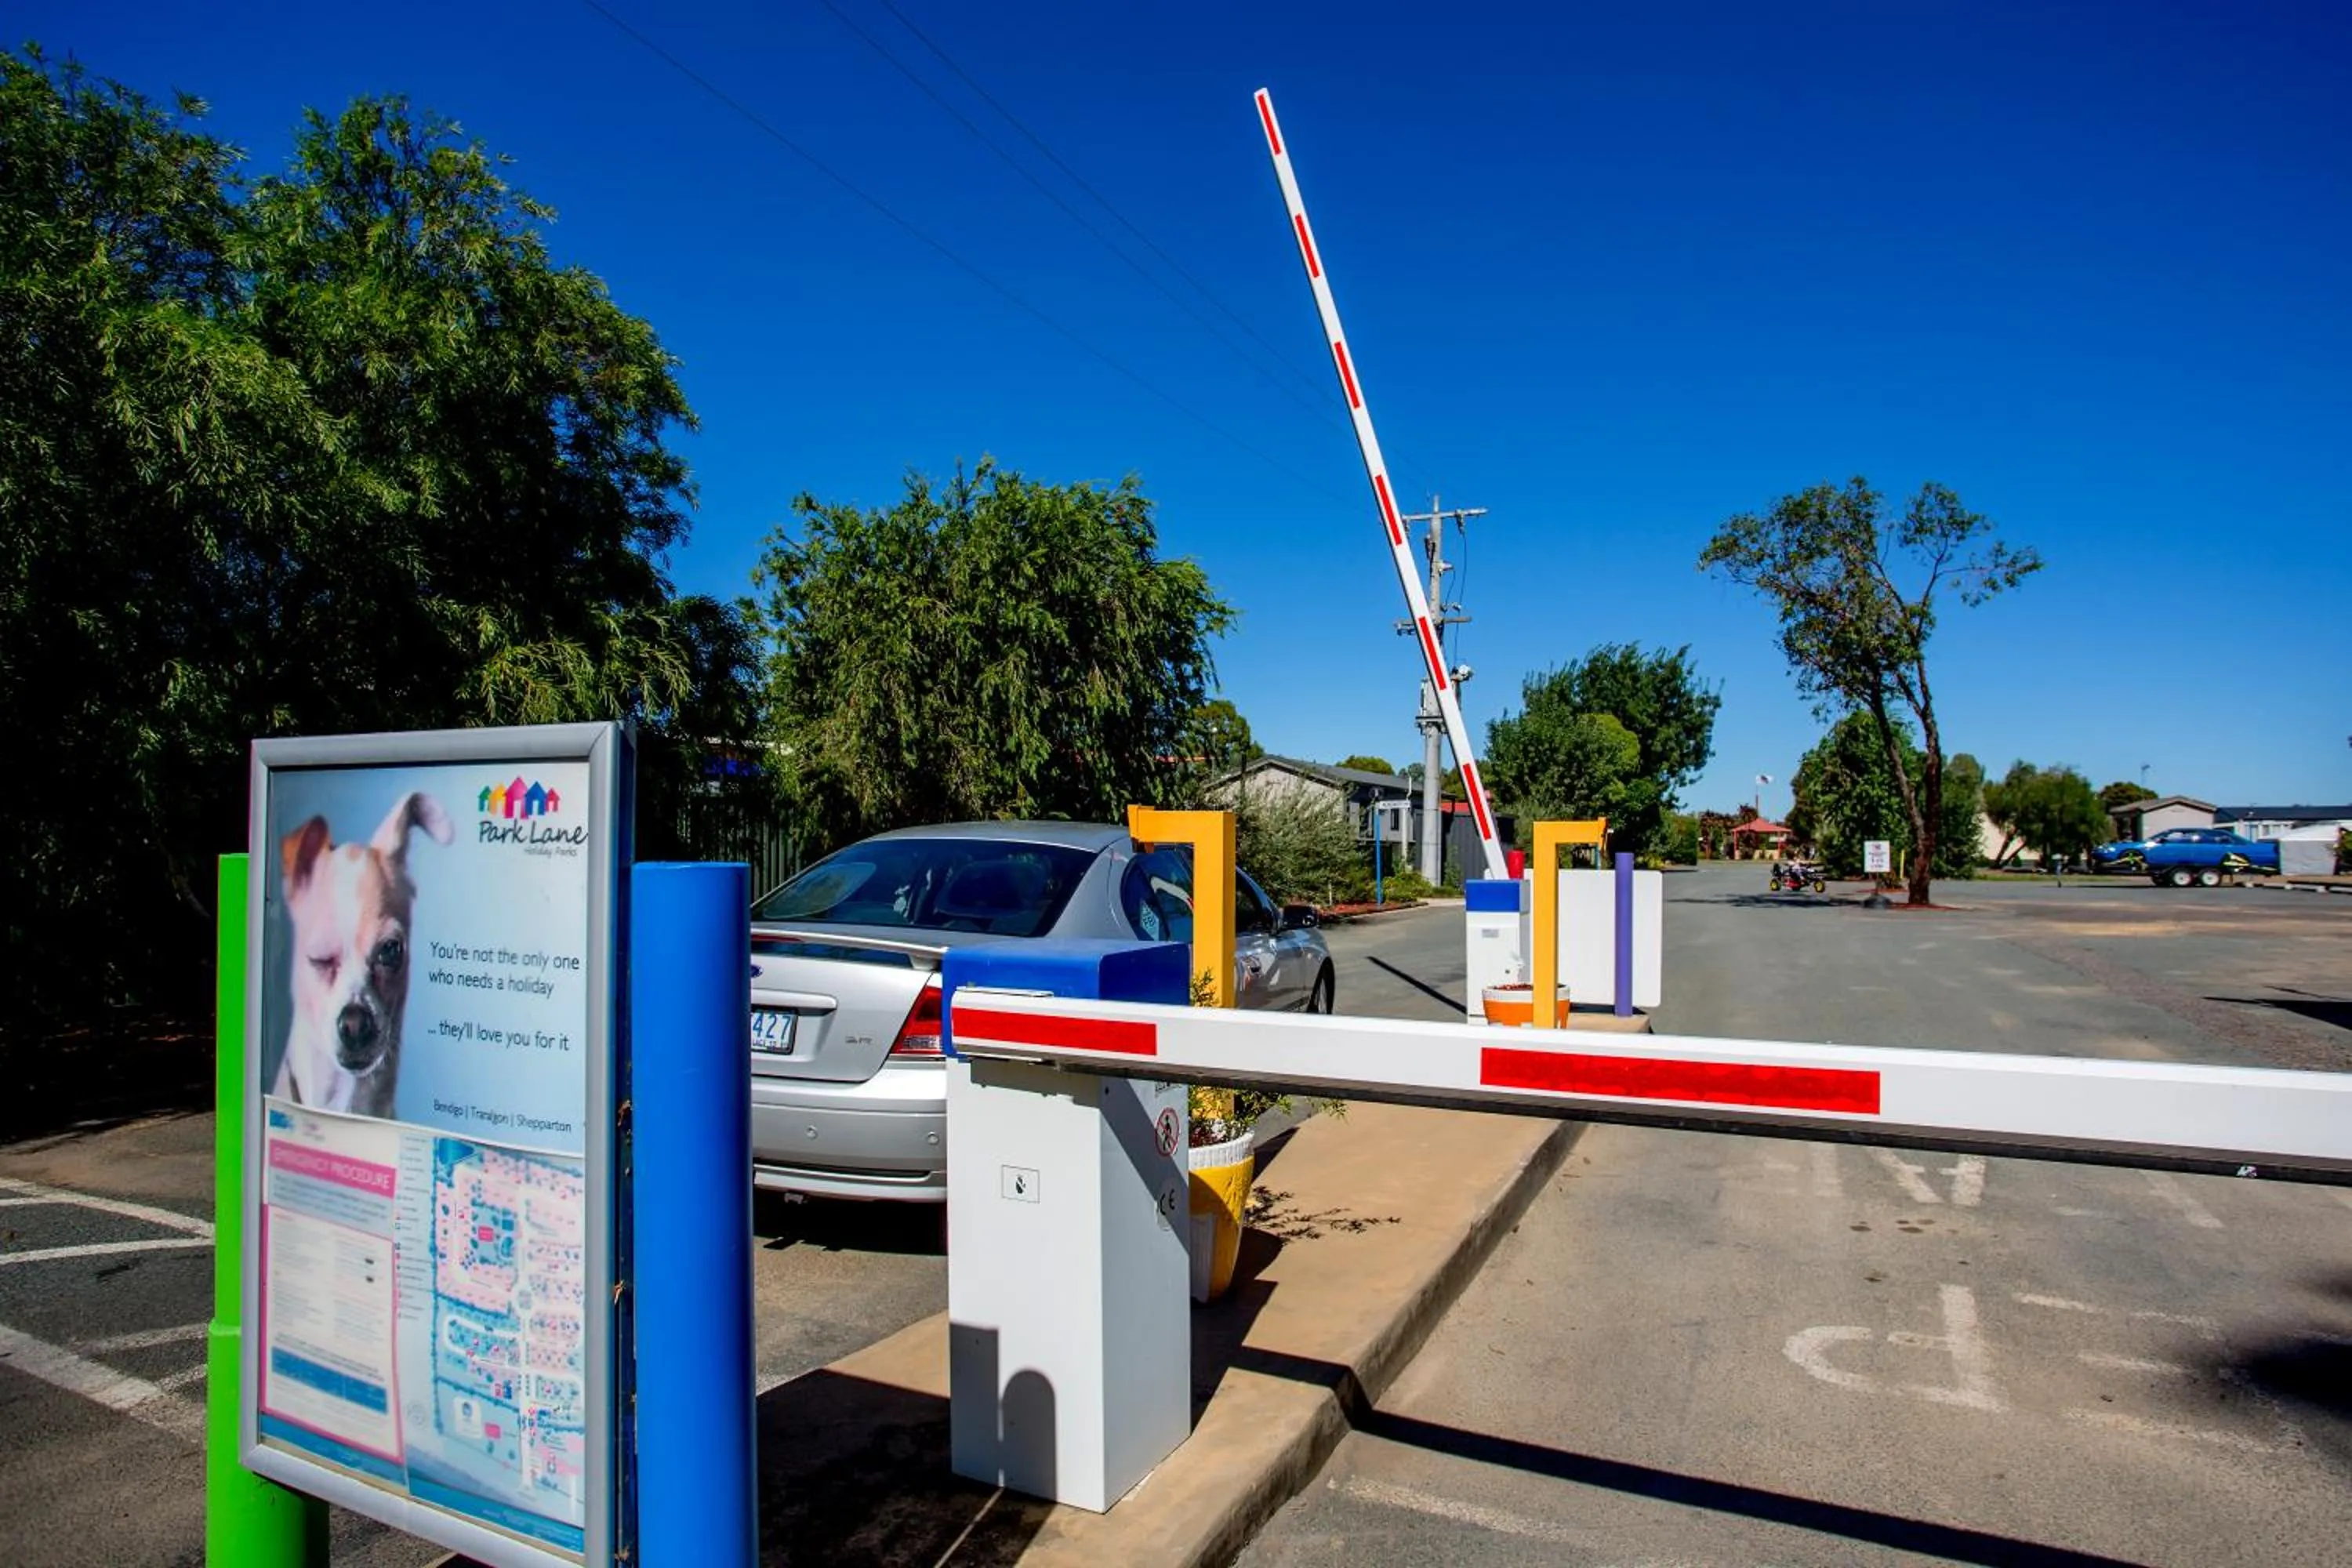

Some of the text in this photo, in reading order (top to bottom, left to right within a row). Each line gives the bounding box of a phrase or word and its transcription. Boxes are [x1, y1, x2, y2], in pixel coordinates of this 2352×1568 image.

[478, 818, 589, 845] Park Lane
[430, 942, 580, 973] You're not the only one
[429, 968, 554, 999] who needs a holiday
[477, 1023, 503, 1043] love
[506, 1032, 530, 1049] you
[535, 1031, 556, 1048] for
[560, 1033, 570, 1051] it
[516, 1113, 572, 1133] Shepparton
